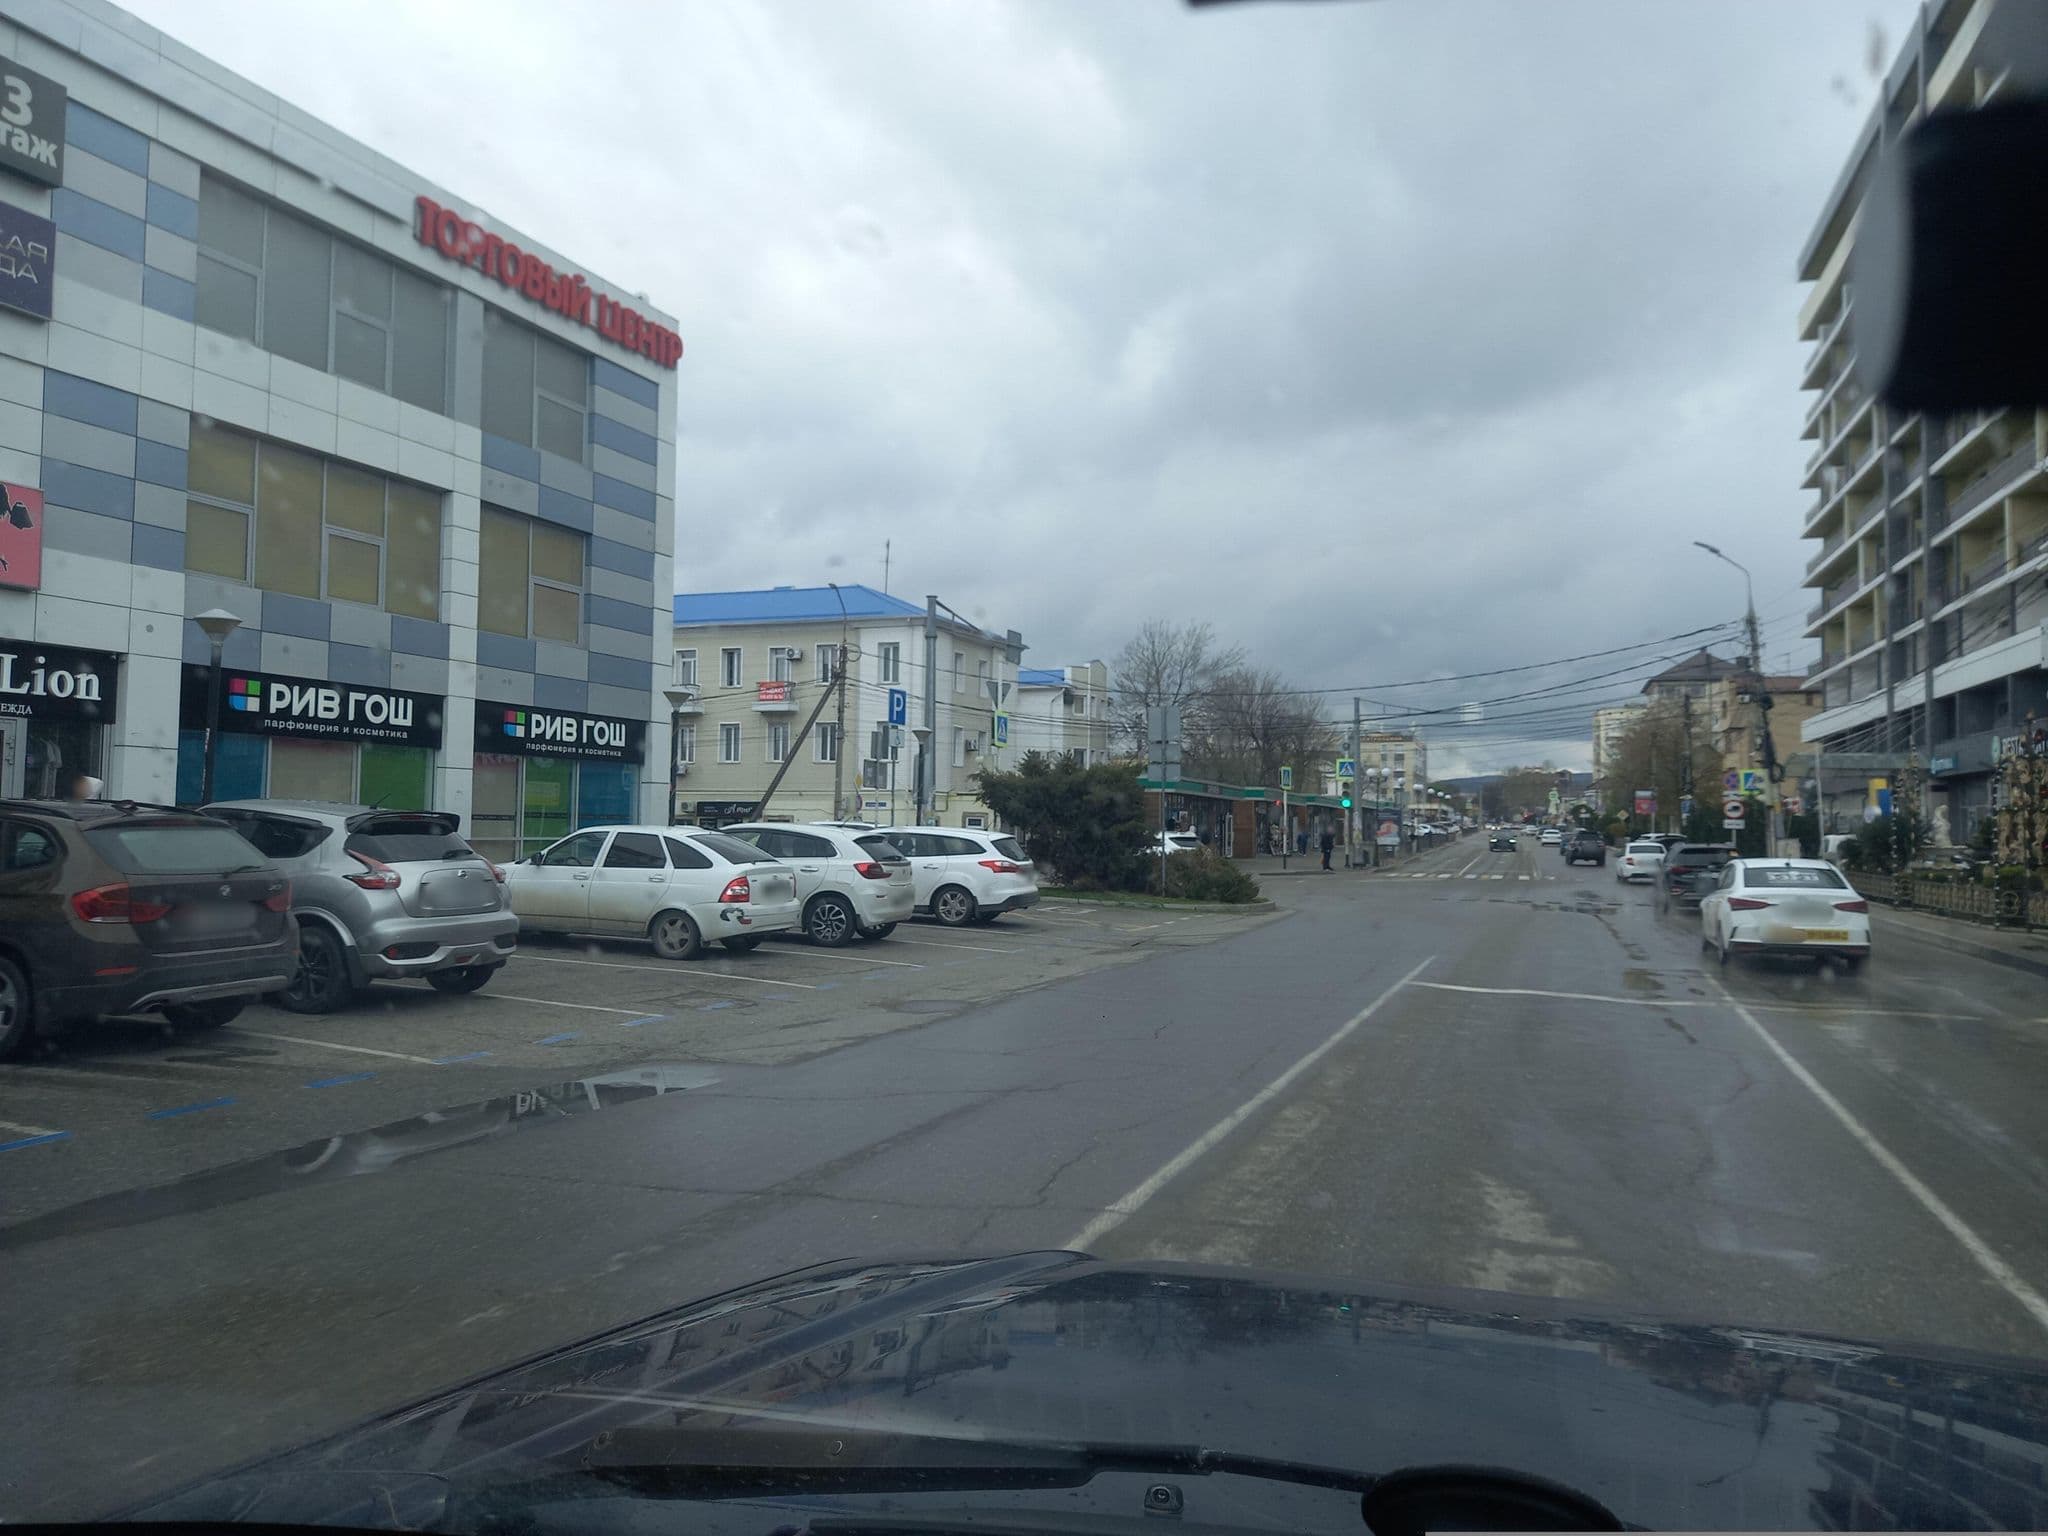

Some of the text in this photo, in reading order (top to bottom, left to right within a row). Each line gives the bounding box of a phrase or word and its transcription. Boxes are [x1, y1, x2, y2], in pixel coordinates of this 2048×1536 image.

[1, 75, 33, 127] 3
[415, 196, 683, 368] ТОРГОВЫЙ ЦЕНТР
[0, 653, 101, 700] Lion
[269, 683, 413, 727] РИВ ГОШ
[264, 718, 340, 733] парфюмерия
[353, 727, 408, 738] косметика
[526, 742, 576, 753] парфюмерия
[585, 747, 622, 757] косметика
[530, 713, 626, 747] РИВ ГОШ
